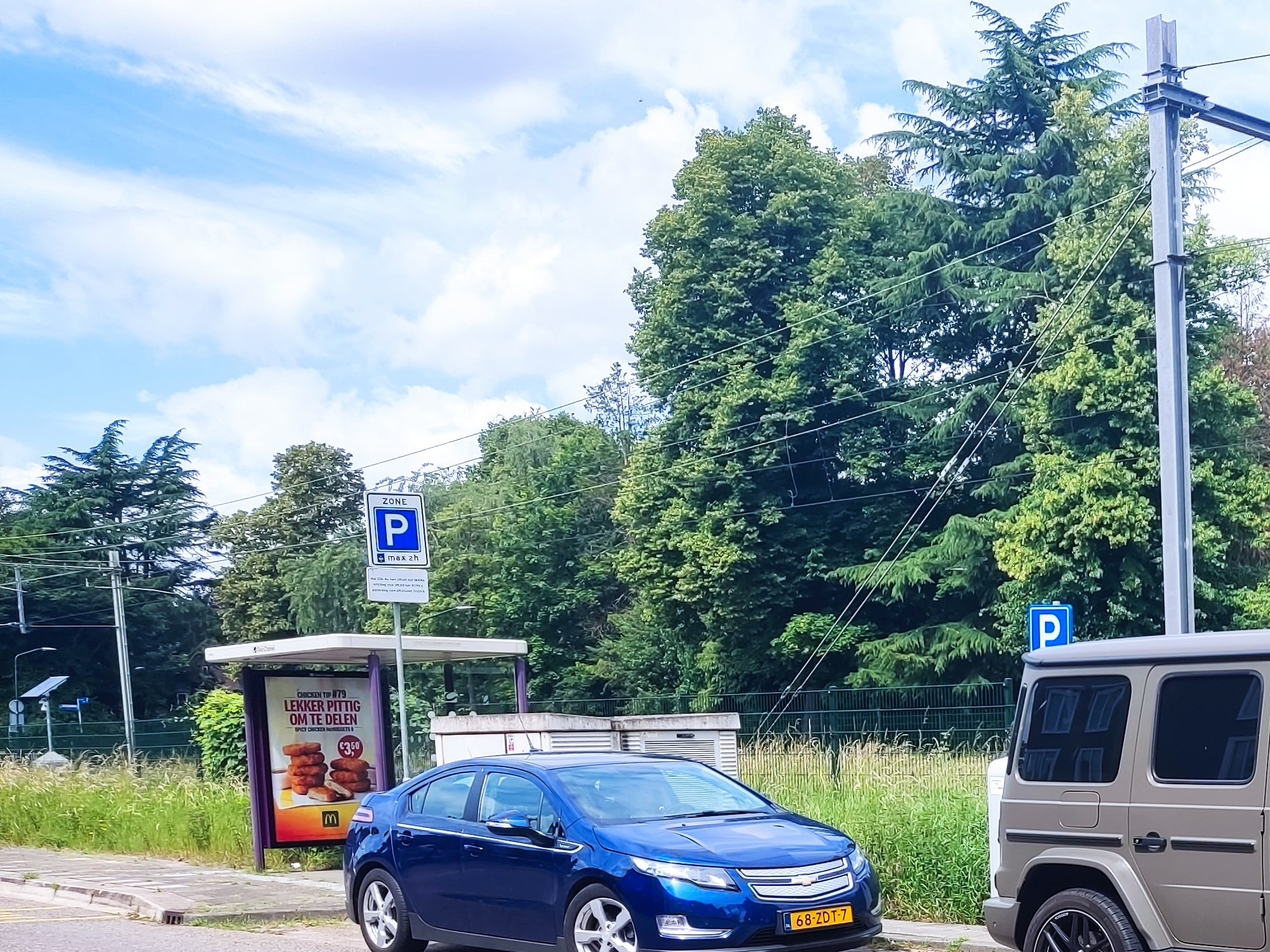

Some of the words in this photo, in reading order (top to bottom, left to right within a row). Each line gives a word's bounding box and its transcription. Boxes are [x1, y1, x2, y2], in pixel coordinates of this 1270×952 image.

[384, 513, 409, 547] P
[1039, 613, 1061, 649] P
[297, 691, 322, 699] CHICKEN
[332, 689, 347, 699] #79
[284, 700, 325, 712] LEKKER
[327, 700, 361, 712] PITTIG
[289, 713, 308, 726] OM
[309, 713, 323, 726] TE
[325, 713, 358, 726] DELEN
[796, 908, 847, 927] 68-ZDT-7
